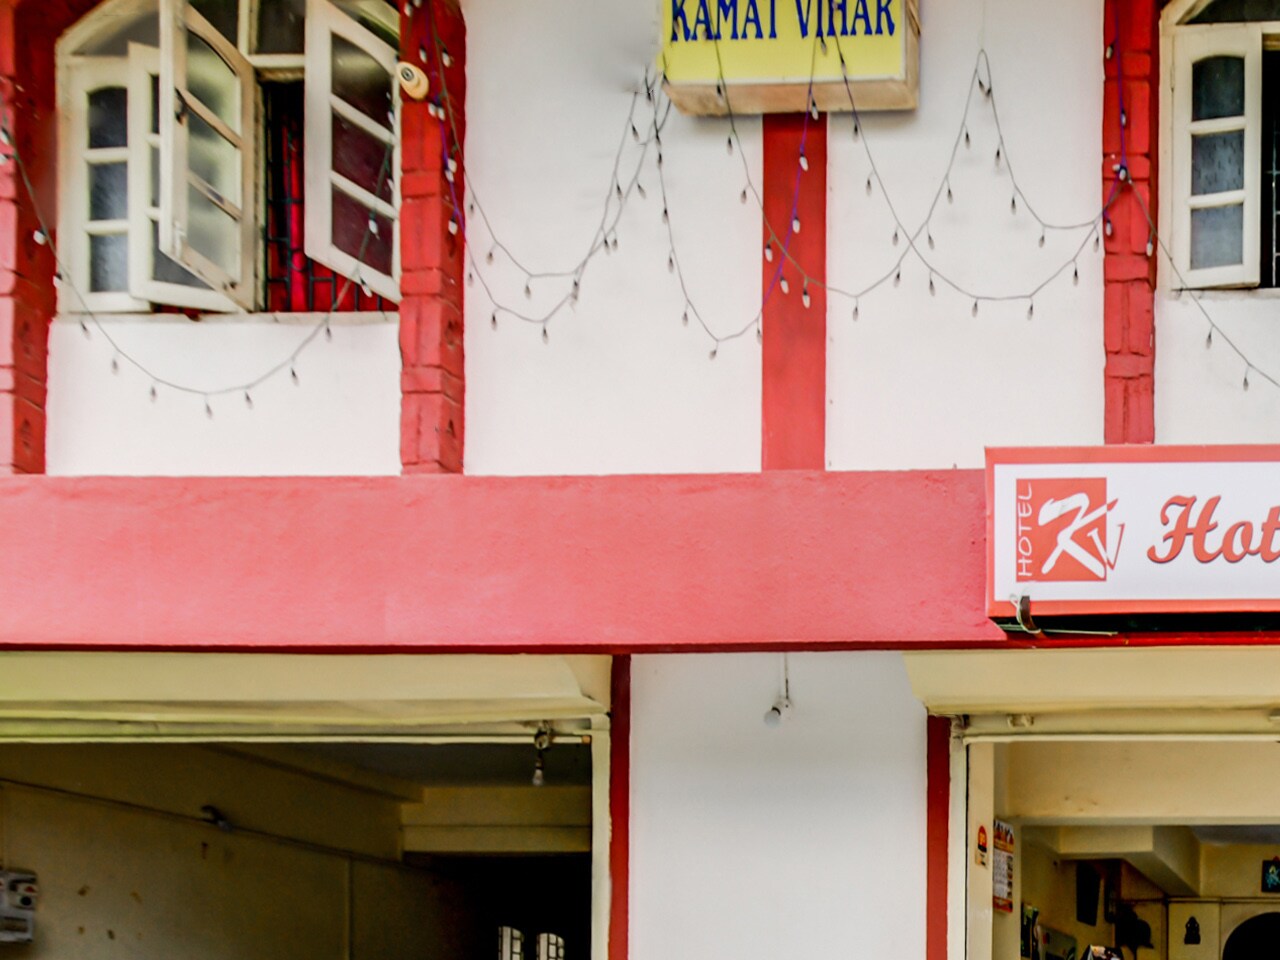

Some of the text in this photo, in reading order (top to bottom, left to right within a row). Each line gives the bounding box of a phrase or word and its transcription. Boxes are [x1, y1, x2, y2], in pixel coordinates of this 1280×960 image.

[671, 0, 895, 41] KAMAT VIHAR
[1018, 481, 1033, 577] HOTEL
